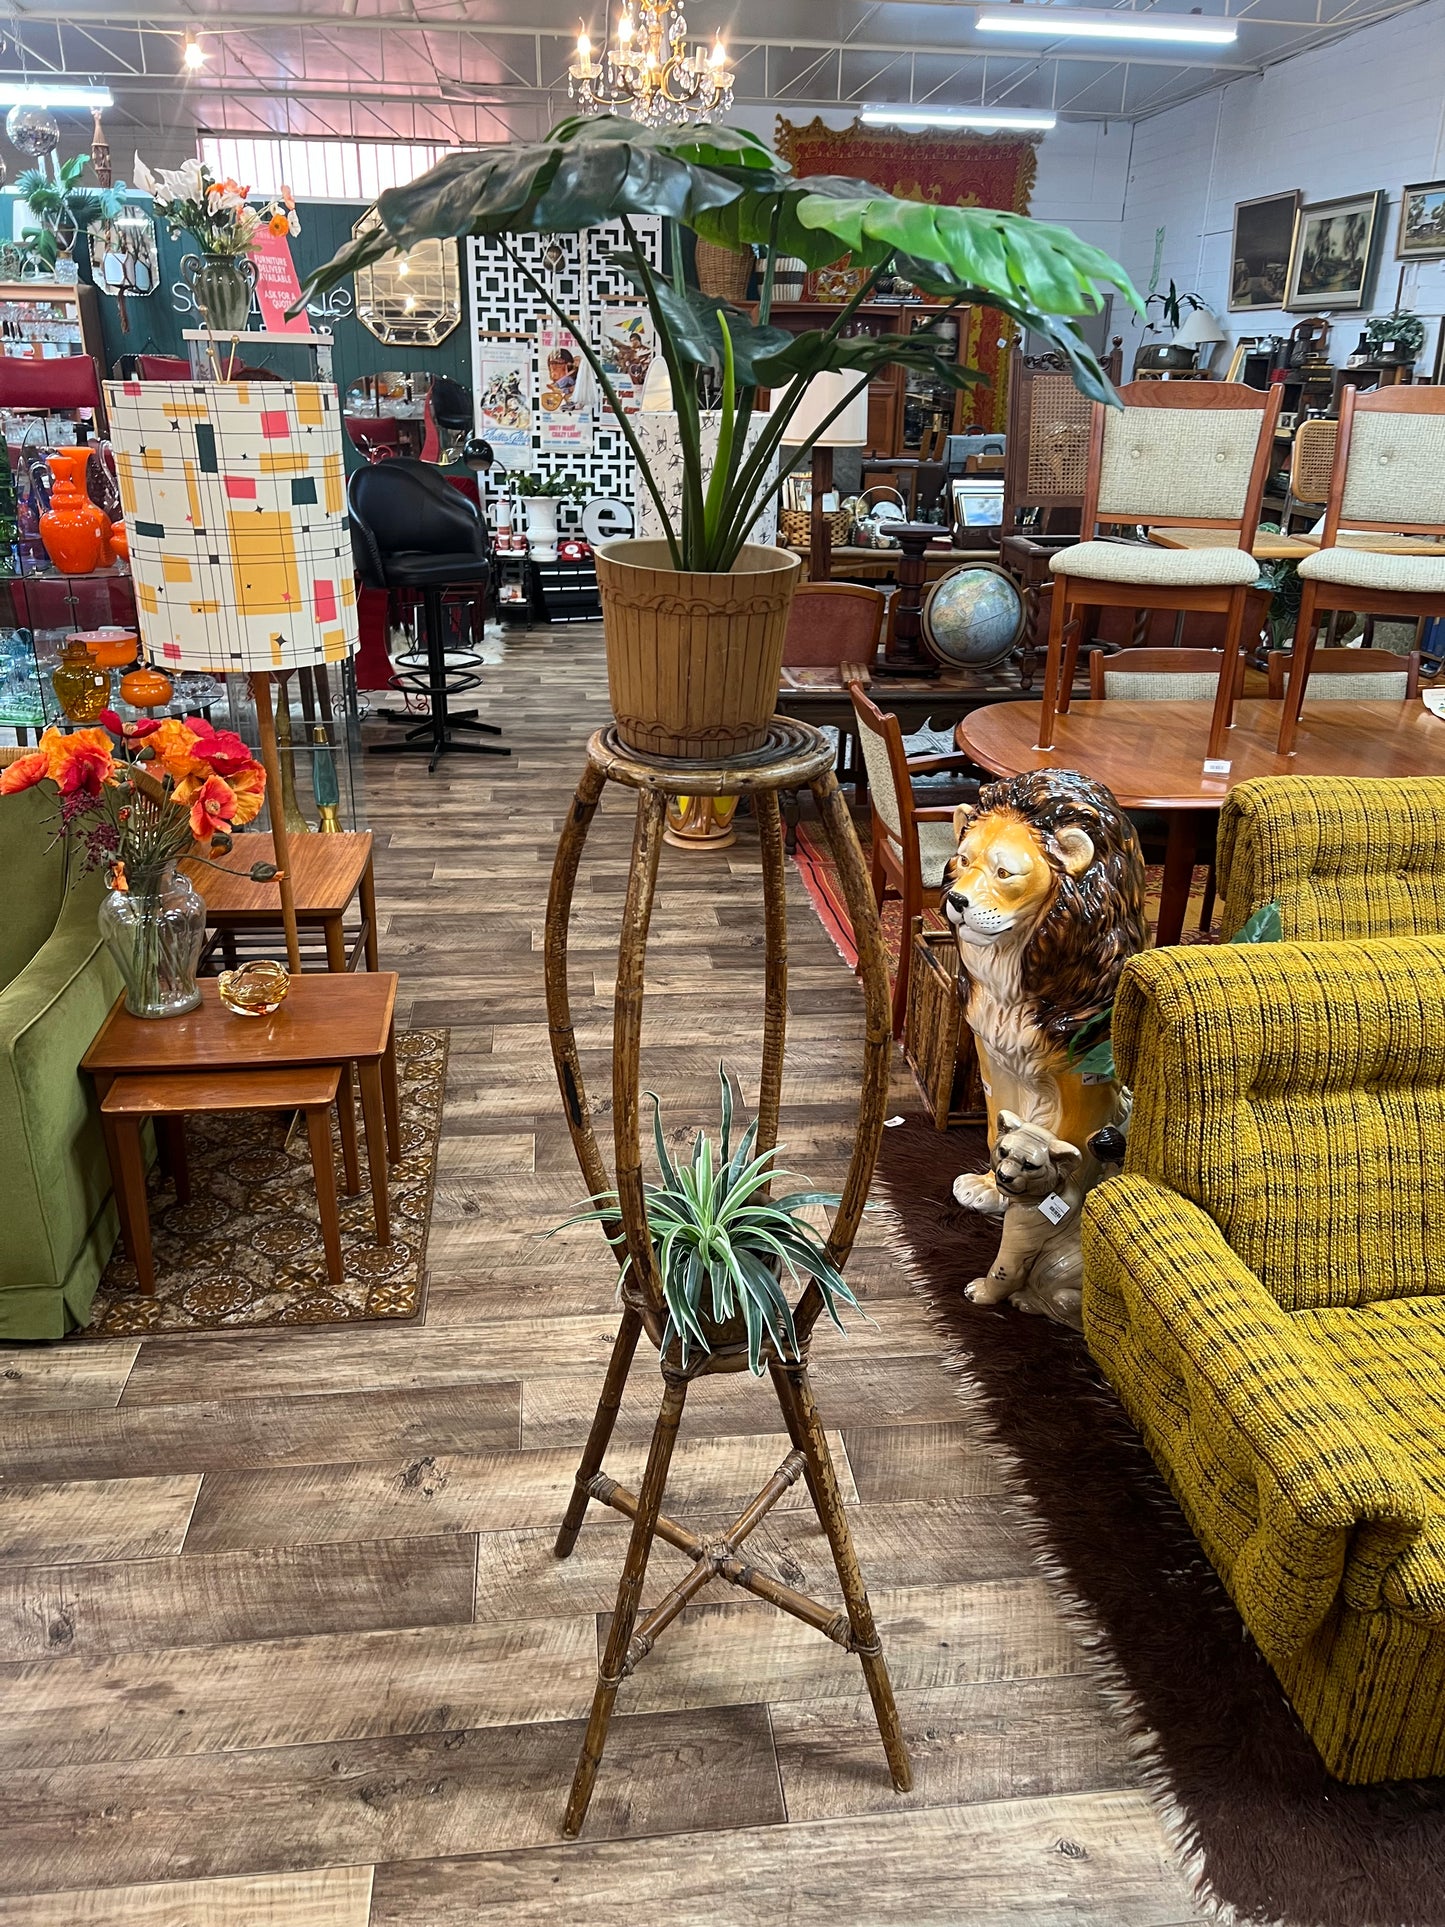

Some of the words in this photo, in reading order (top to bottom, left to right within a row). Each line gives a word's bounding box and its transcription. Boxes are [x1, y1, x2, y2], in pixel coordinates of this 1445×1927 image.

[254, 254, 288, 267] FURNITURE
[257, 263, 286, 274] DELIVERY
[259, 272, 292, 284] AVAILABLE
[264, 290, 277, 299] ASK
[277, 290, 290, 300] FOR
